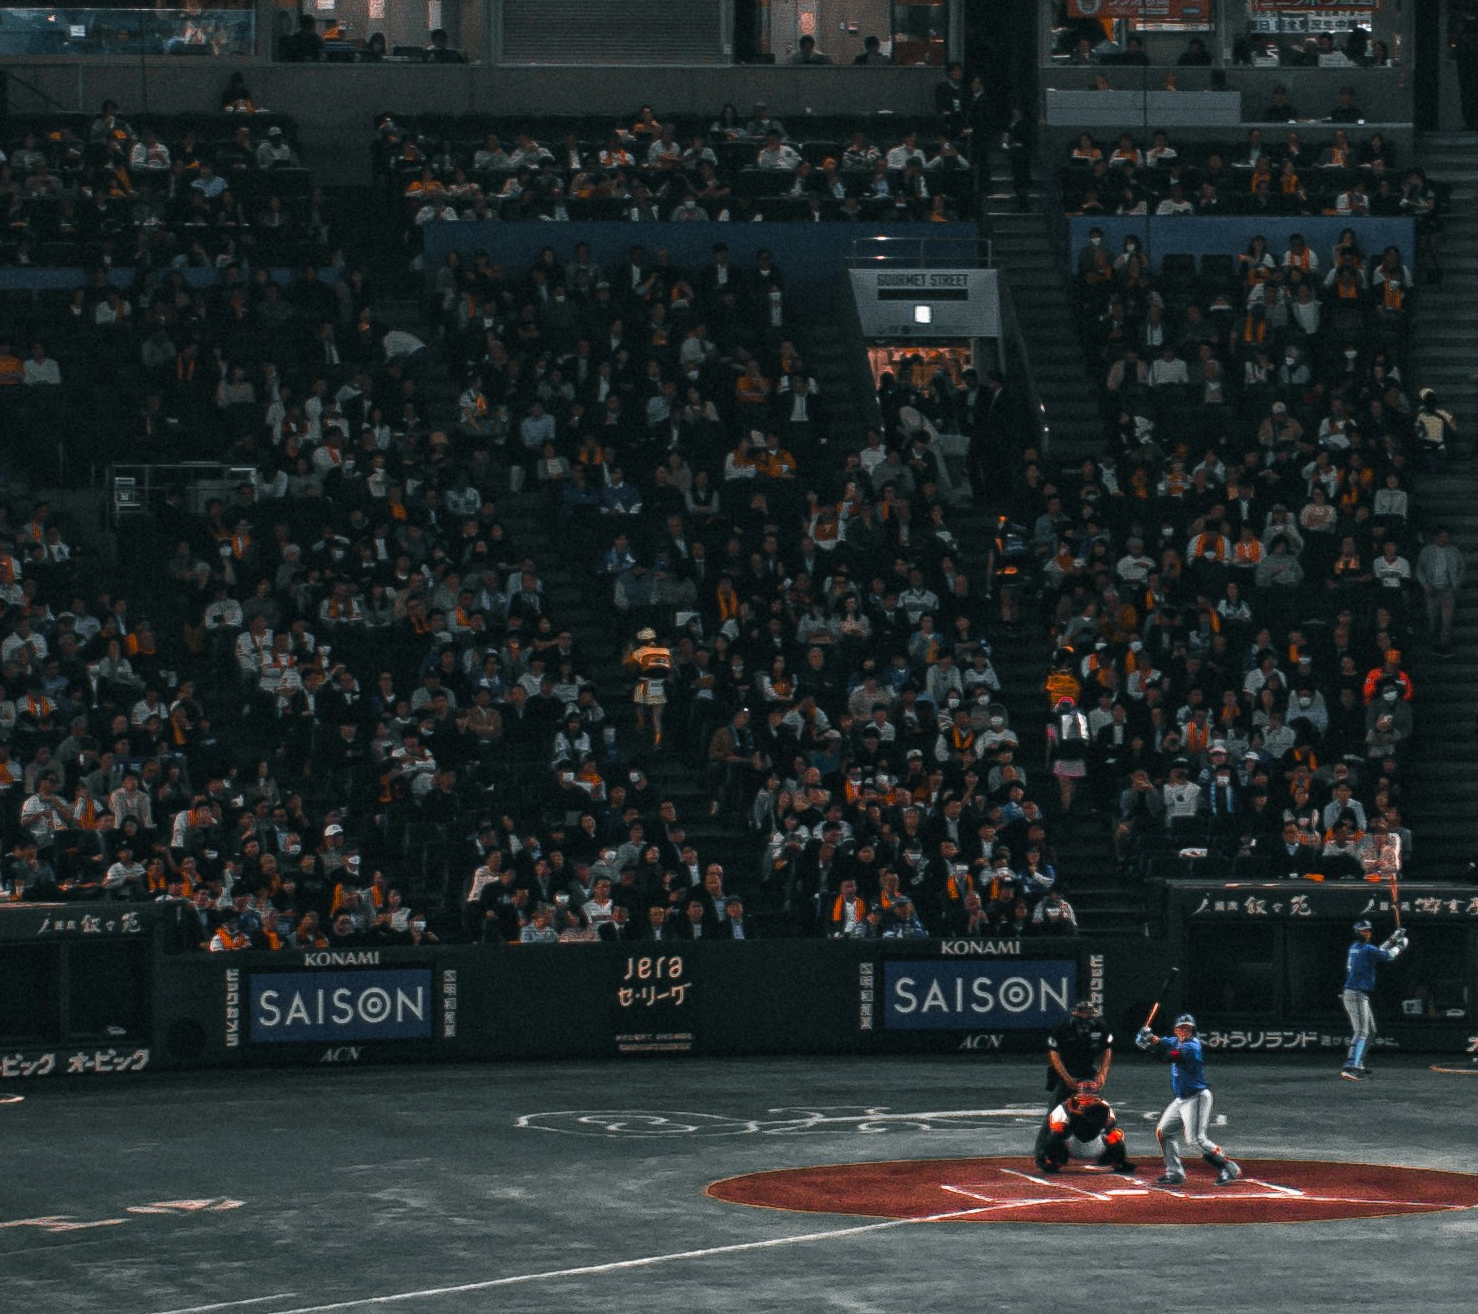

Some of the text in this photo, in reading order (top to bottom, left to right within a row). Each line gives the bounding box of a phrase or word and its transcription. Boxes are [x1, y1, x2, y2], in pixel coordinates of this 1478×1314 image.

[876, 273, 969, 288] GOURMET STREET
[939, 939, 1022, 956] KONAMI
[303, 950, 381, 967] KONAMI
[893, 975, 1069, 1015] SAISON
[257, 984, 425, 1028] SAISON
[958, 1034, 1005, 1050] ACN
[66, 1048, 152, 1074] オービック
[320, 1046, 364, 1063] ACN
